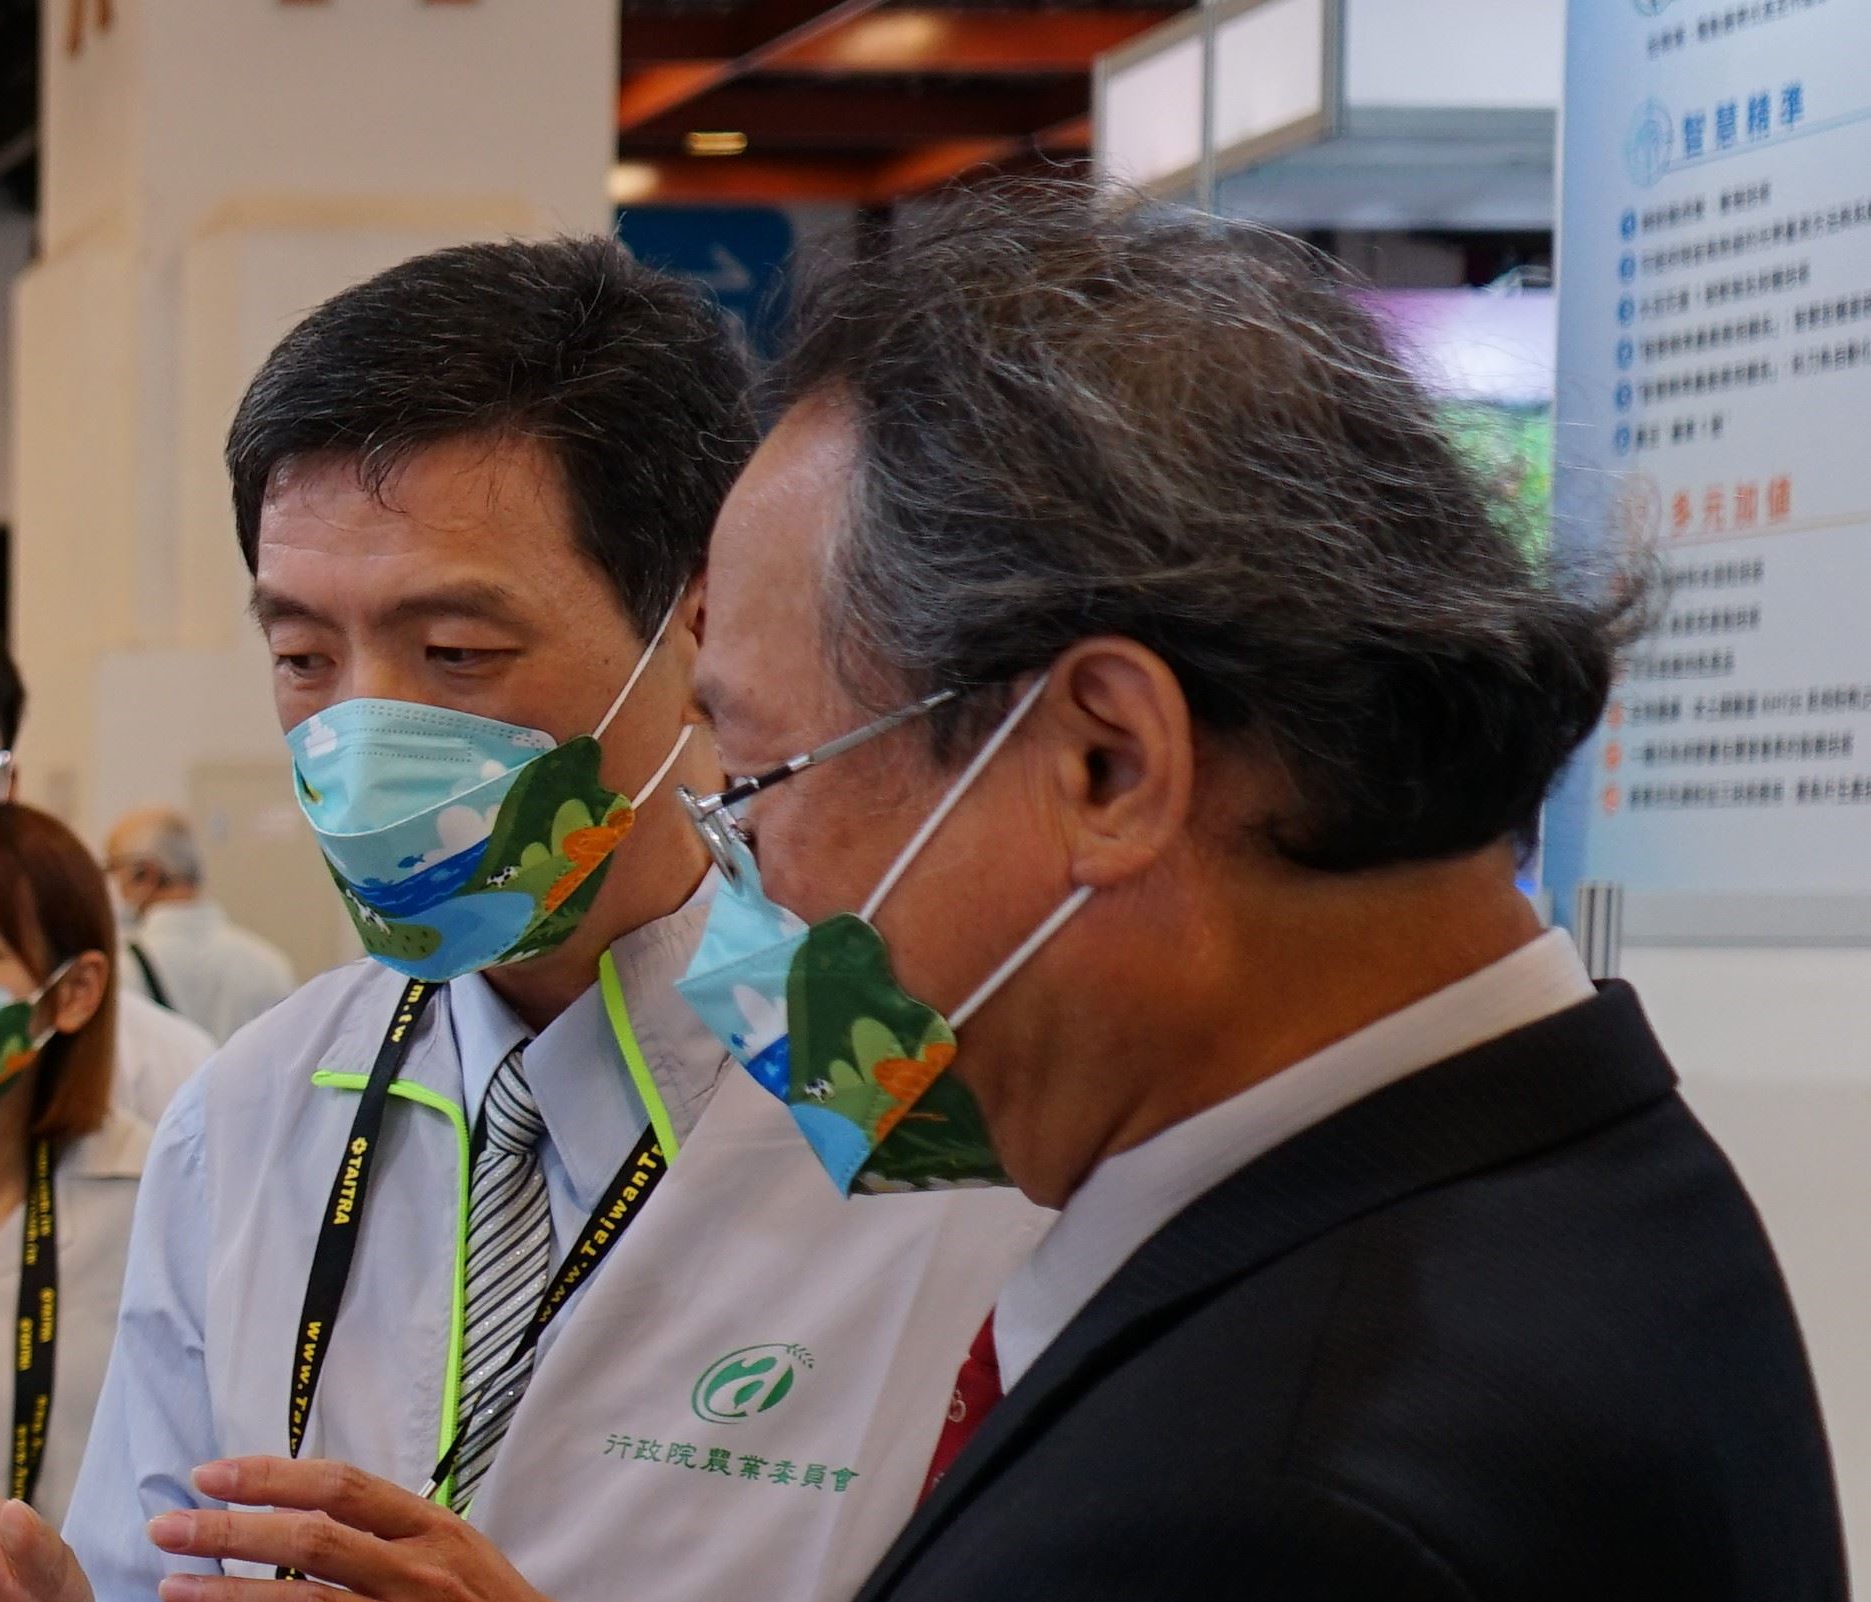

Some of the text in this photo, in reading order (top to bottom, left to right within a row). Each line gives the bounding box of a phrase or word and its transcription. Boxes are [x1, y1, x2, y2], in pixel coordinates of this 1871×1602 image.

[333, 1151, 363, 1226] TAITRA
[603, 1433, 860, 1492] 行政院農業委員會
